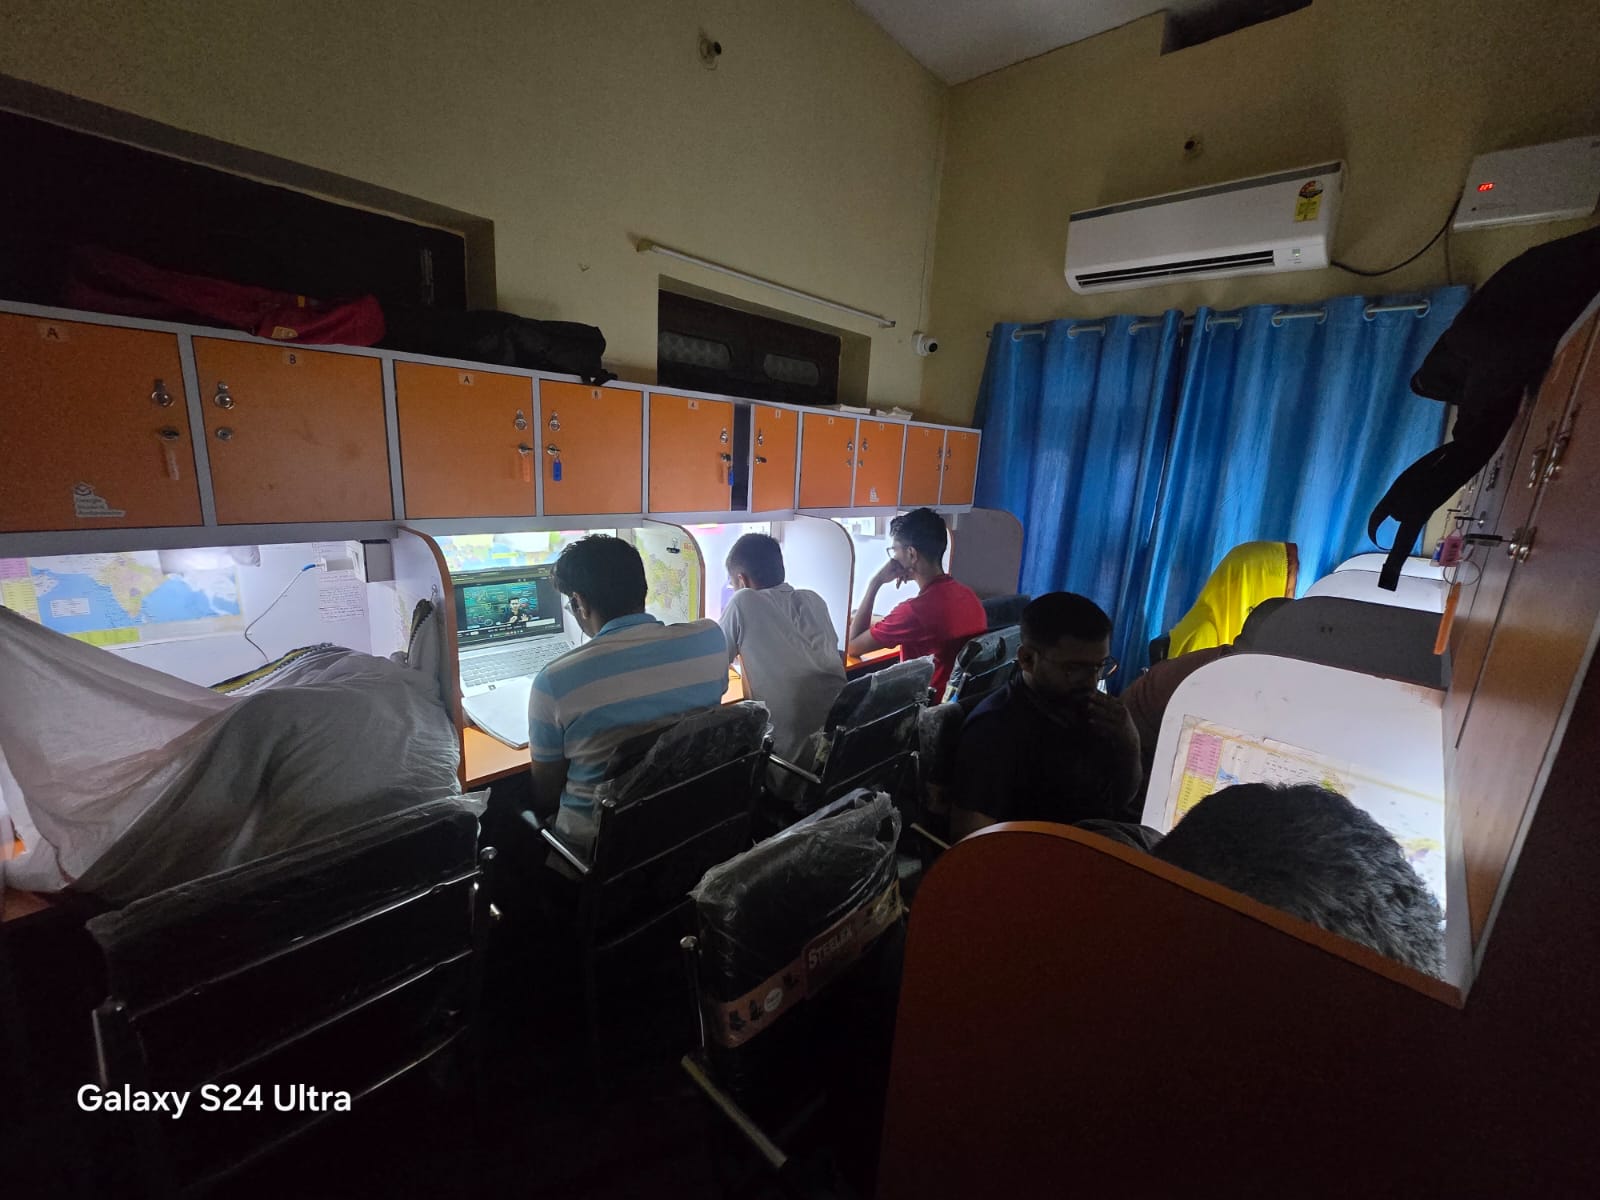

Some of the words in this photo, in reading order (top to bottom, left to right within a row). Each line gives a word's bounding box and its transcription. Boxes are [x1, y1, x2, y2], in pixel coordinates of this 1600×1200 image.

[47, 327, 58, 339] A
[289, 354, 297, 364] B
[463, 375, 470, 384] A
